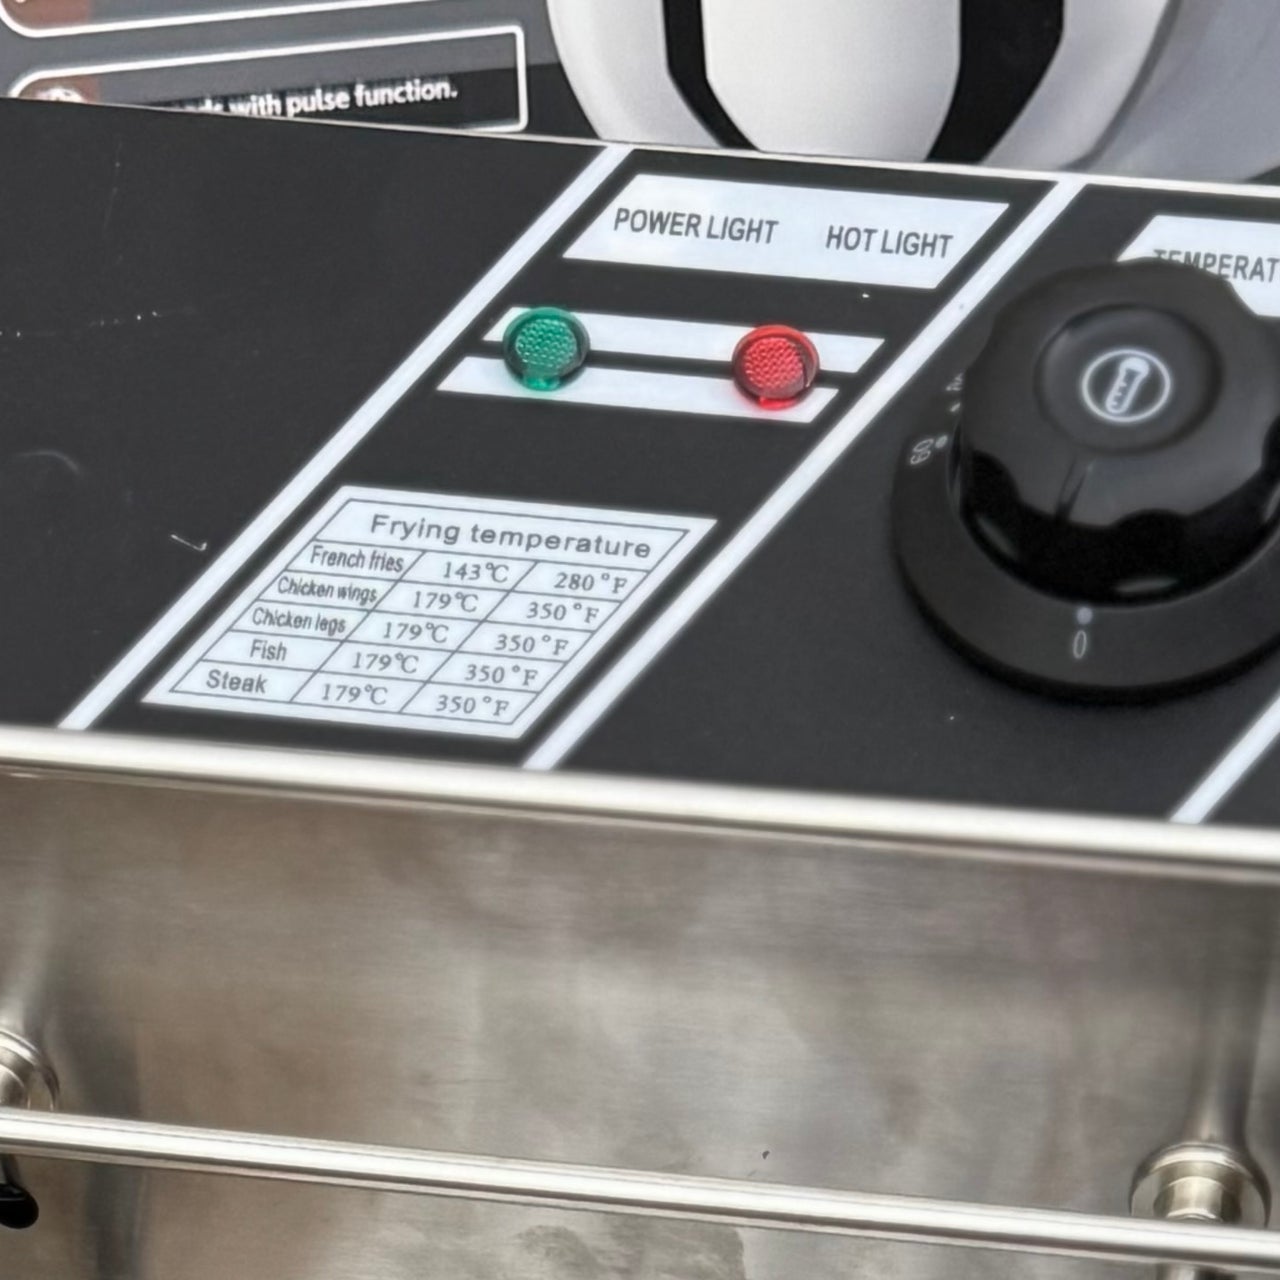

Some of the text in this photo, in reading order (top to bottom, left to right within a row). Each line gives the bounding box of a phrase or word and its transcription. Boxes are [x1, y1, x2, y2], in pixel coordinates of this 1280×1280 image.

[286, 88, 349, 118] pulse
[355, 79, 458, 108] function.
[613, 207, 780, 245] POWER LIGHT
[826, 225, 954, 258] HOT LIGHT
[370, 514, 651, 560] Frying temperature
[310, 545, 404, 573] French fries
[277, 575, 378, 607] Chicken wings
[252, 607, 346, 637] Chicken legs
[249, 640, 287, 663] Fish
[205, 669, 267, 694] Steak
